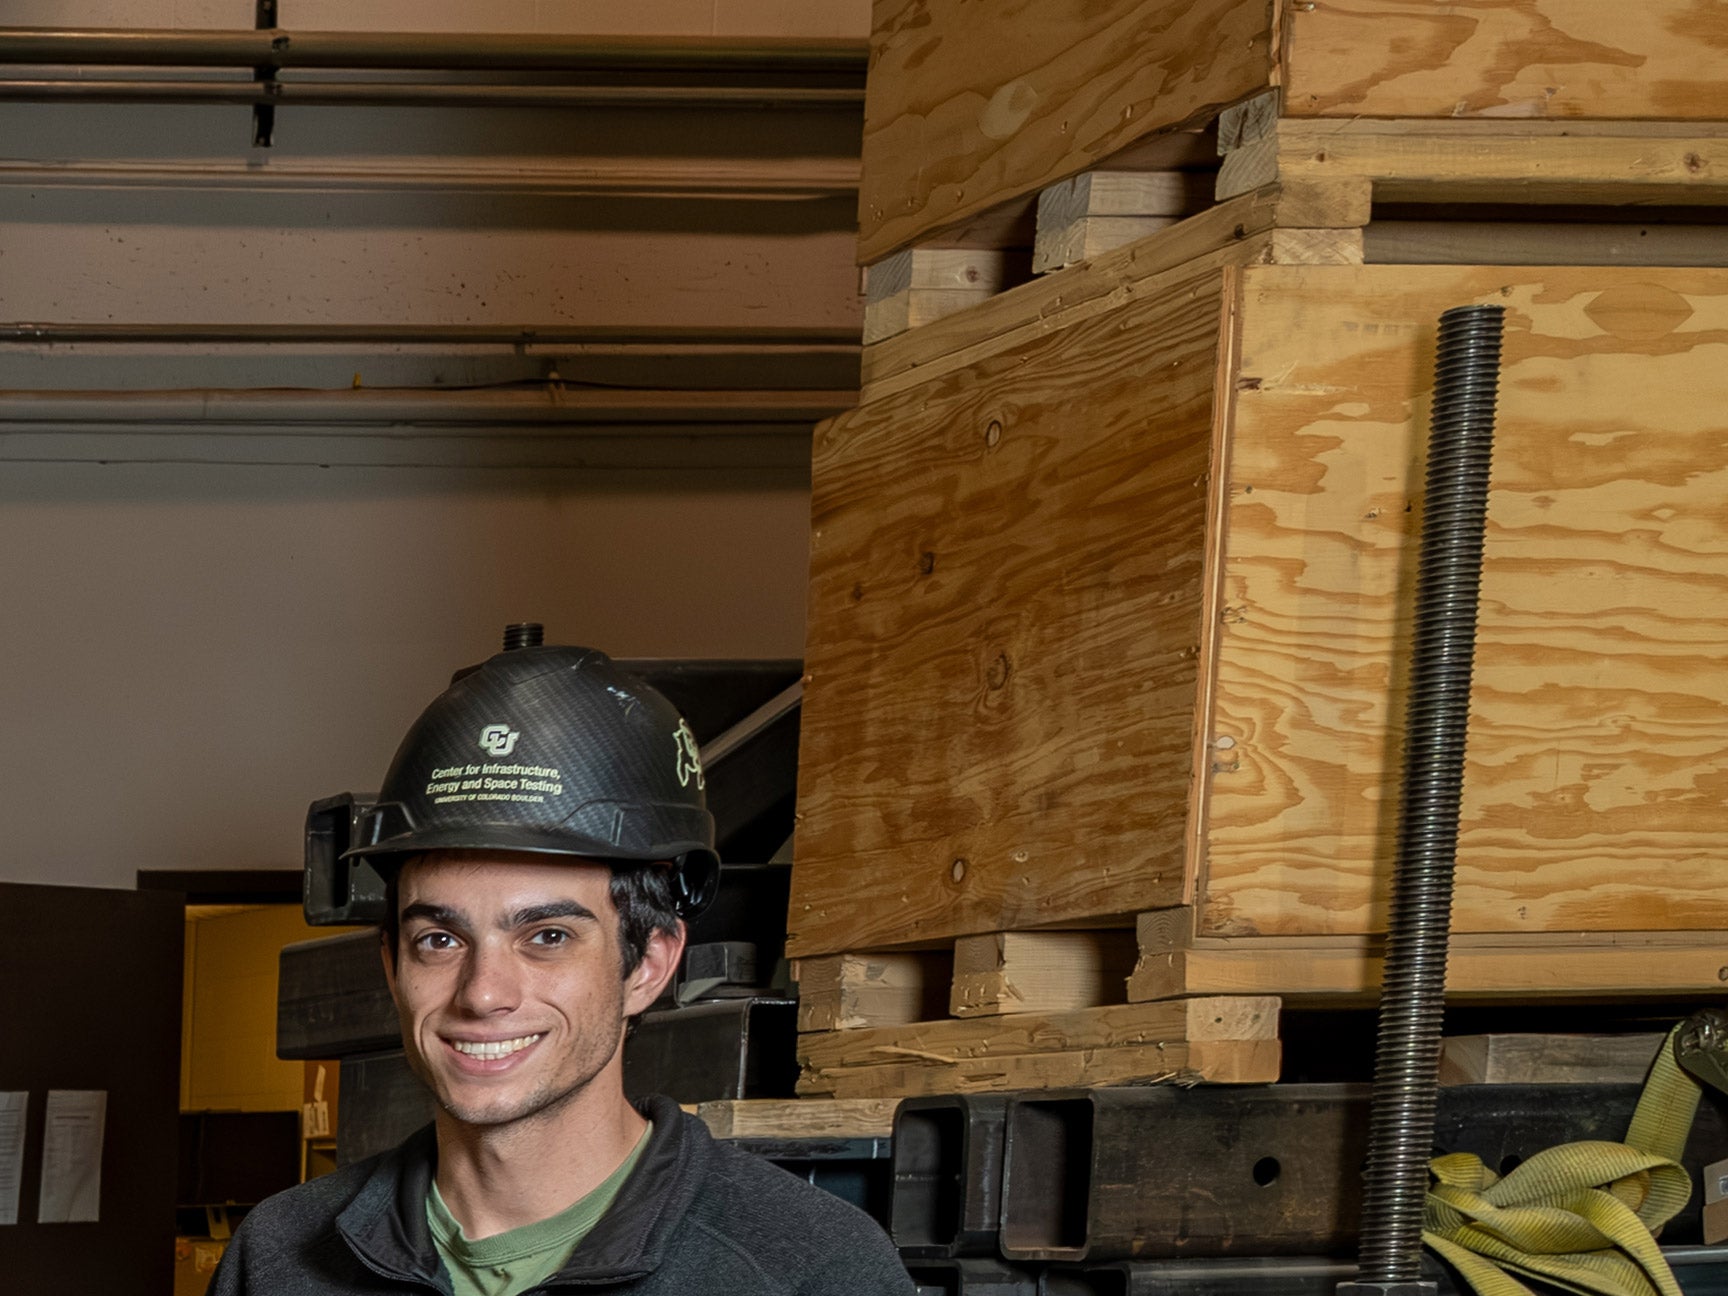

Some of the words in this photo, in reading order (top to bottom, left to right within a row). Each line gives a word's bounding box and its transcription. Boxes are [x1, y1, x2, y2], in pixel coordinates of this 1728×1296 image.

[432, 766, 463, 780] Center
[465, 763, 479, 775] for
[482, 763, 561, 780] Infrastructure,
[425, 781, 460, 795] Energy
[461, 778, 482, 790] and
[483, 777, 517, 791] Space
[519, 778, 562, 796] Testing
